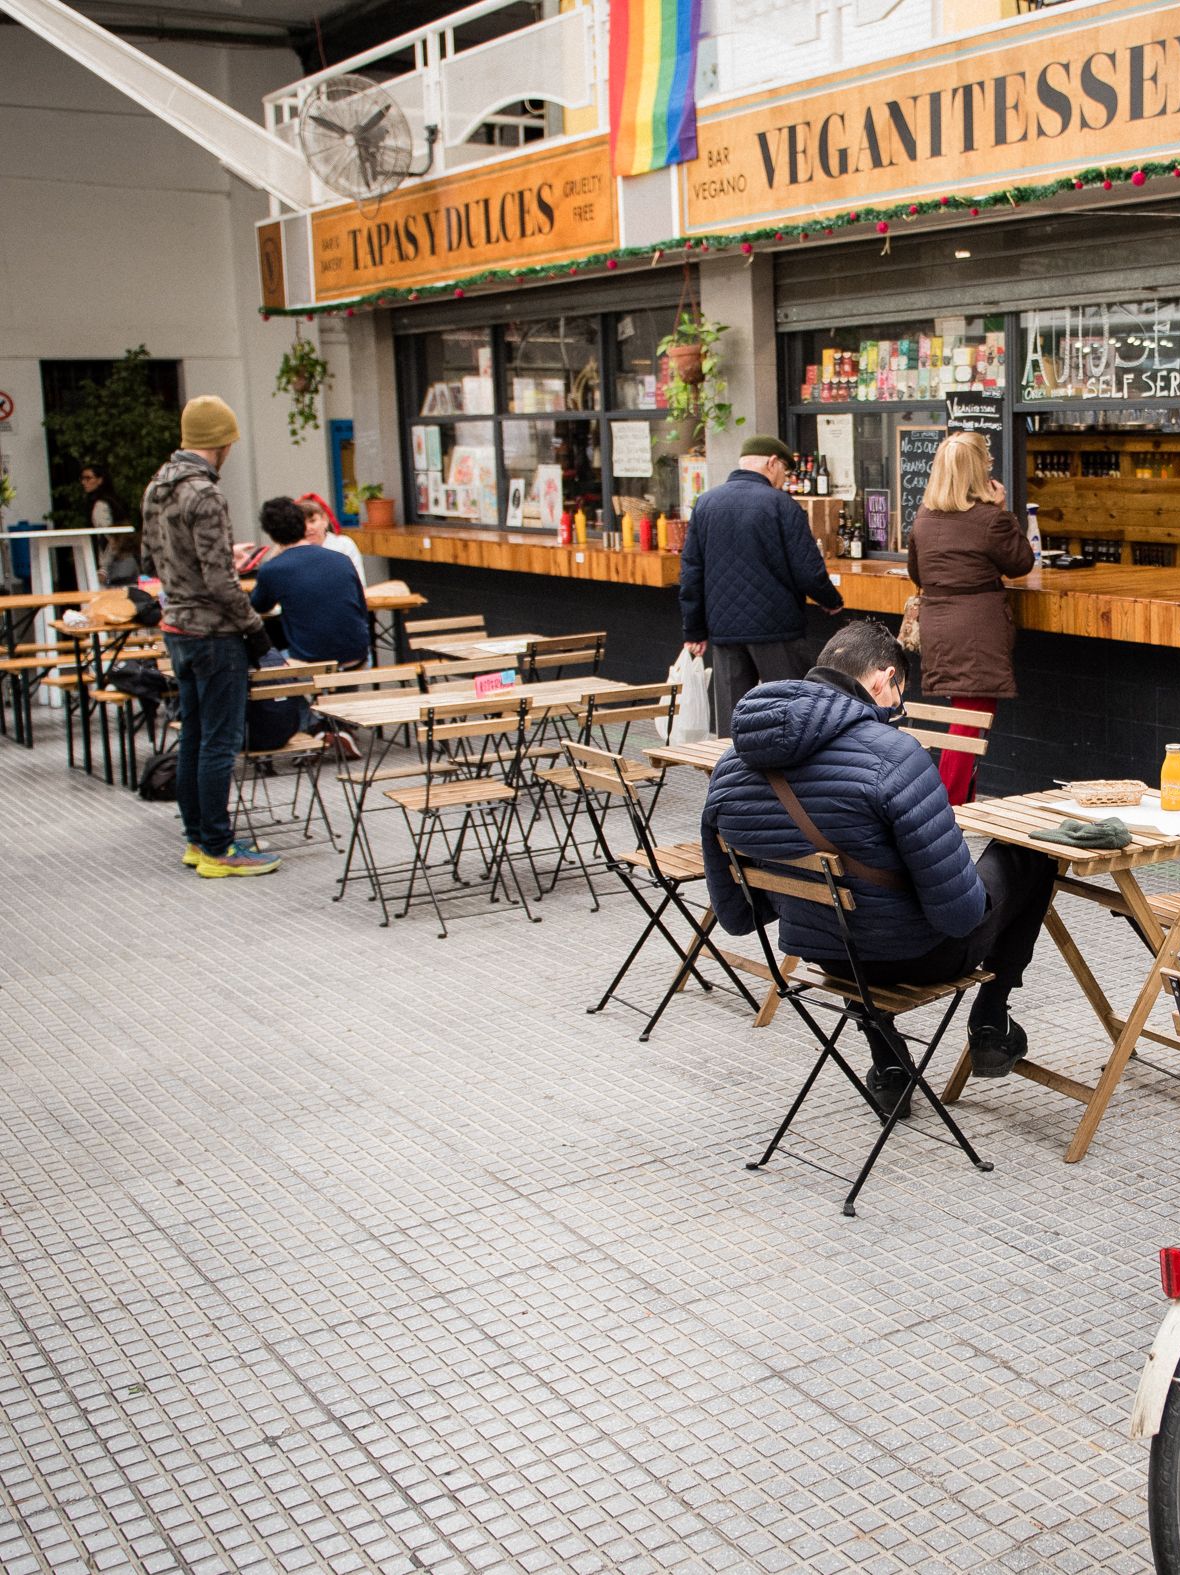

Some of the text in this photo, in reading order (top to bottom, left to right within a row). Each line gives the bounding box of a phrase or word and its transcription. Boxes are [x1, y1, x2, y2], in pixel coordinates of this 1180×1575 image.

[707, 146, 731, 168] BAR
[562, 174, 602, 198] CRUELTY
[693, 174, 747, 200] VEGANO
[573, 203, 594, 222] FREE
[348, 182, 555, 271] TAPAS Y DULCES
[1082, 374, 1134, 400] SELF
